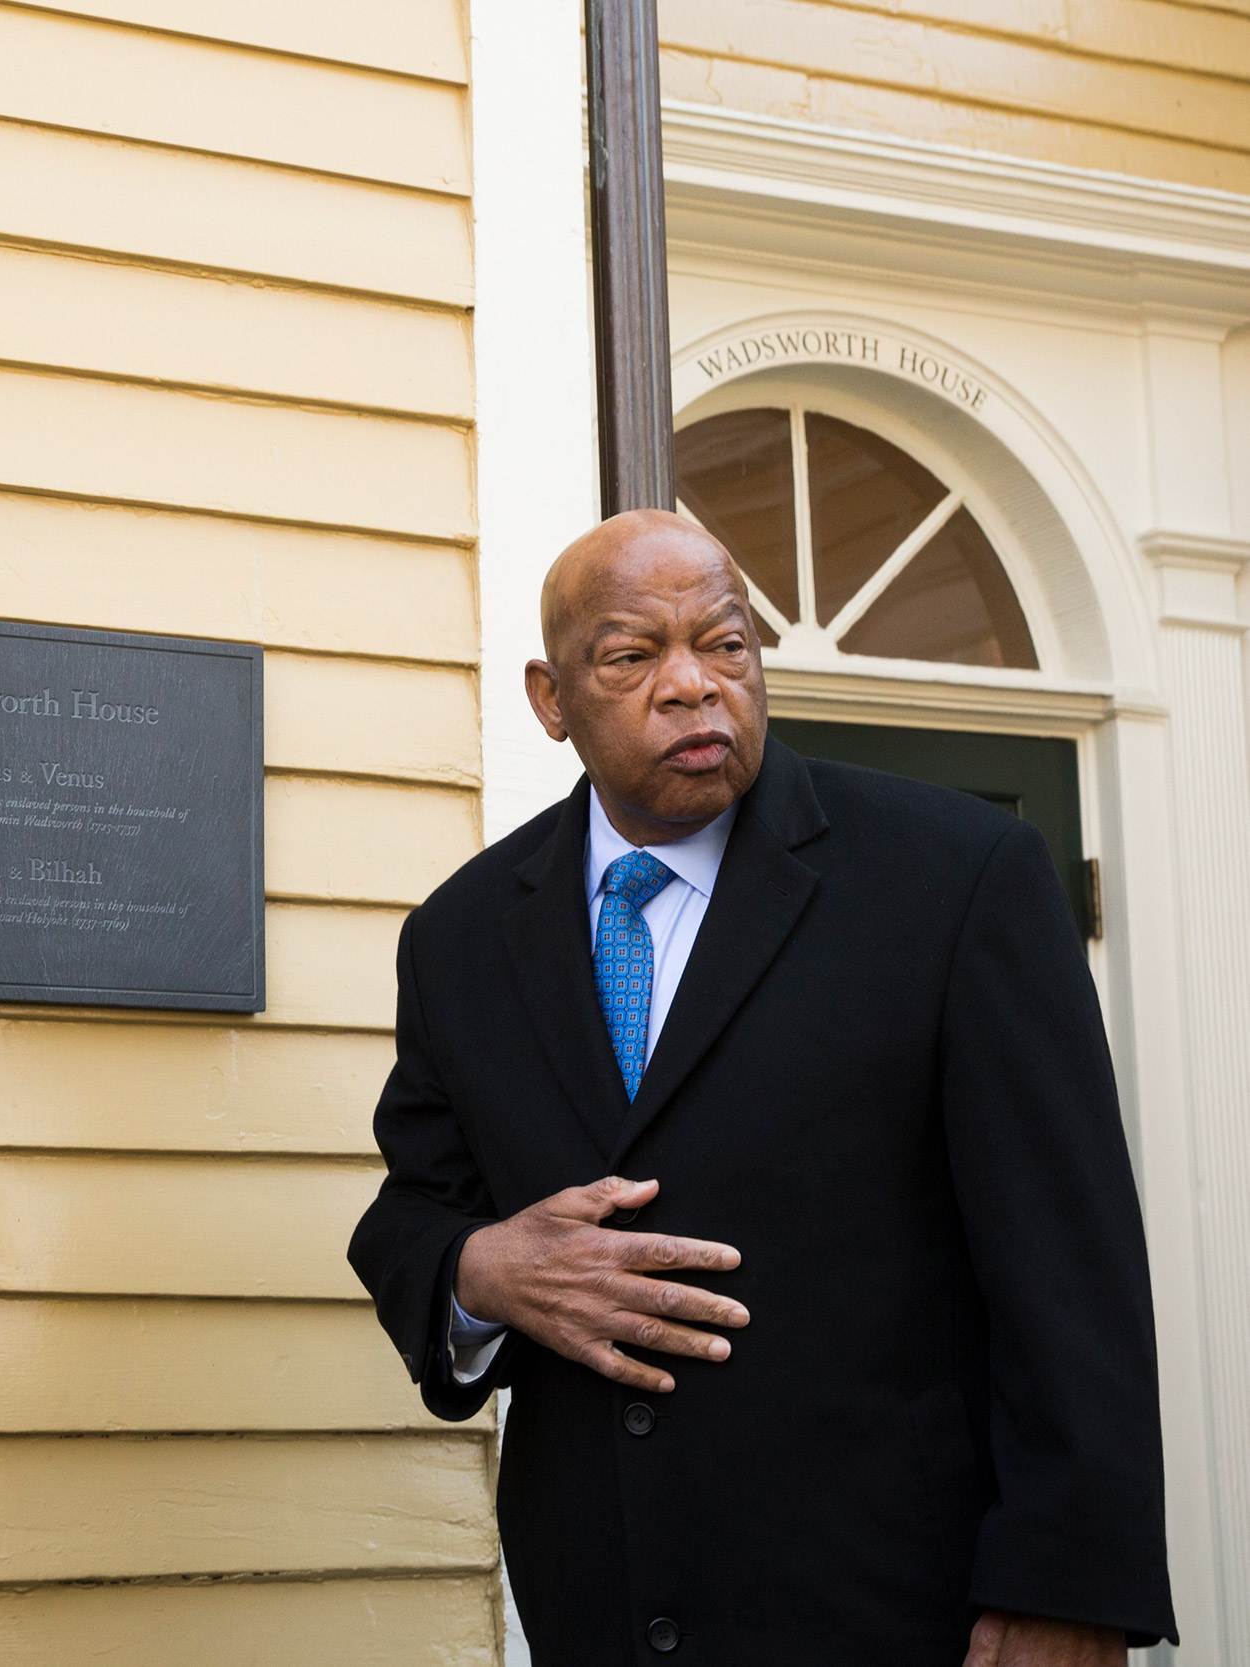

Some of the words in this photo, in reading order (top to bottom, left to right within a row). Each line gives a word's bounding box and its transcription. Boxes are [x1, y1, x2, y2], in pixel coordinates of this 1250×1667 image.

[697, 330, 879, 379] WADSWORTH
[900, 348, 988, 412] HOUSE
[71, 689, 159, 725] House
[20, 770, 33, 783] &
[40, 761, 104, 789] Venus
[6, 797, 51, 810] enslaved
[52, 803, 90, 815] persons
[94, 803, 104, 814] in
[108, 804, 123, 815] the
[127, 805, 176, 819] household
[179, 809, 190, 823] of
[24, 815, 83, 830] Wadsworth
[9, 866, 22, 880] &
[29, 857, 102, 884] Bilhah
[5, 895, 50, 907] enslaved
[53, 898, 90, 911] persons
[94, 898, 104, 909] in
[108, 900, 123, 911] the
[127, 901, 176, 914] household
[179, 904, 190, 918] of
[25, 911, 67, 928] Holyoke
